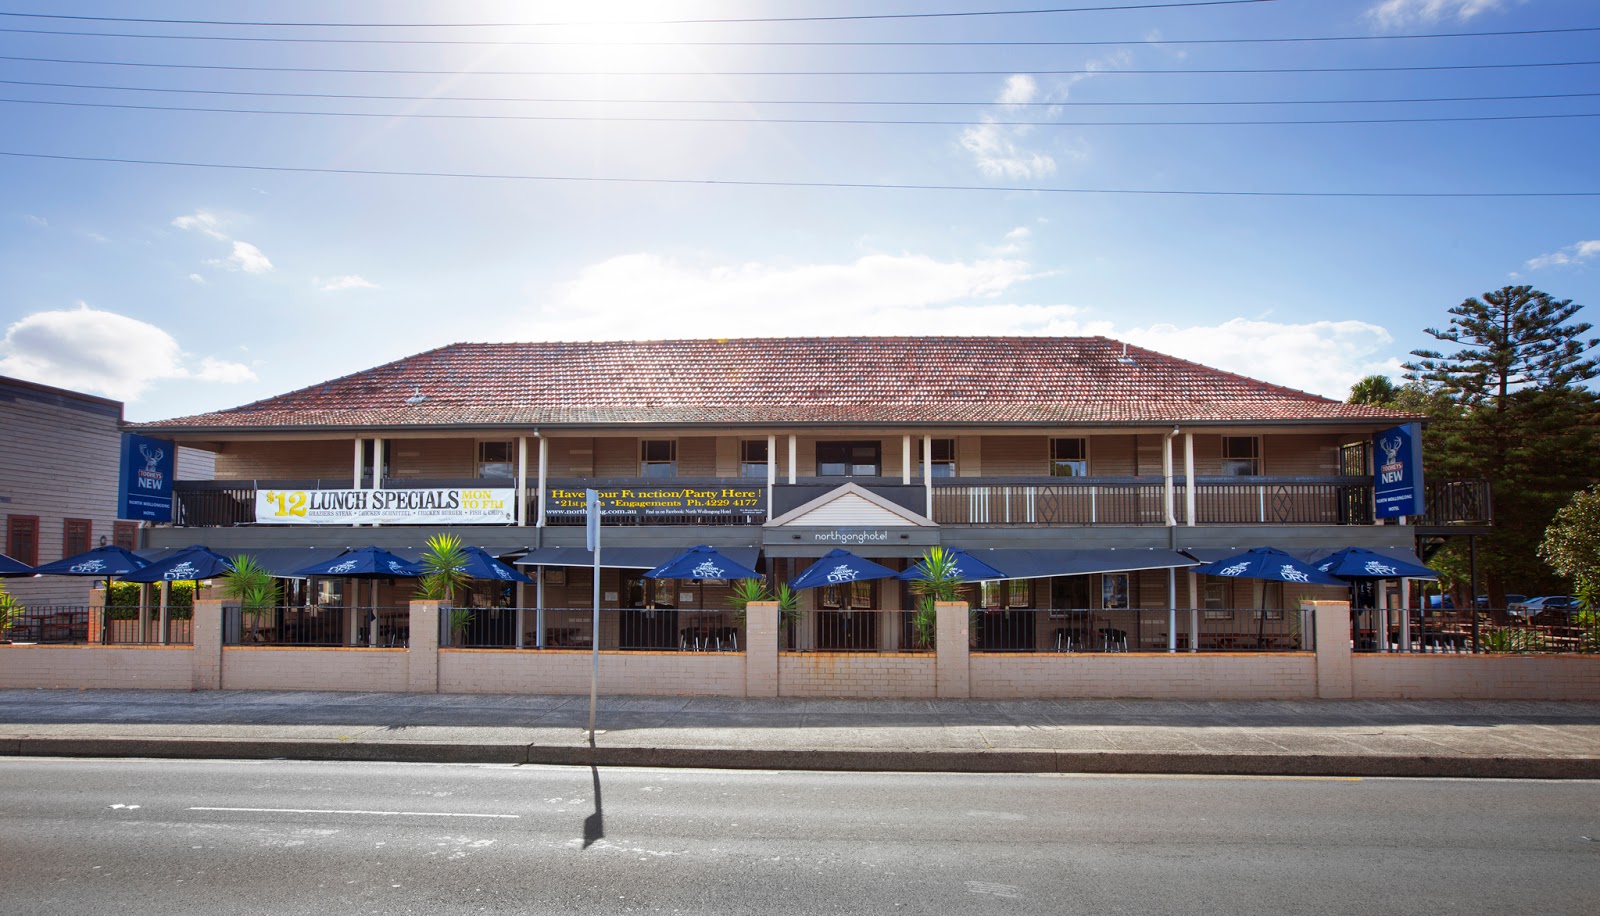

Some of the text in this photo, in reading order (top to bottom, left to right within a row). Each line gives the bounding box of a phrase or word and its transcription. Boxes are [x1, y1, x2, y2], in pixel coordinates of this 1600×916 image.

[1382, 470, 1403, 484] NEW
[138, 477, 163, 490] NEW
[461, 490, 491, 499] MON
[551, 490, 585, 498] Have
[595, 489, 619, 498] our
[721, 489, 755, 498] Here
[266, 490, 307, 517] $12
[309, 490, 459, 510] LUNCH SPECIALS
[461, 500, 504, 509] TO FRI
[815, 530, 887, 543] northgonghotel
[163, 569, 199, 579] DRY
[827, 571, 859, 582] DRY
[1281, 572, 1309, 582] DRY
